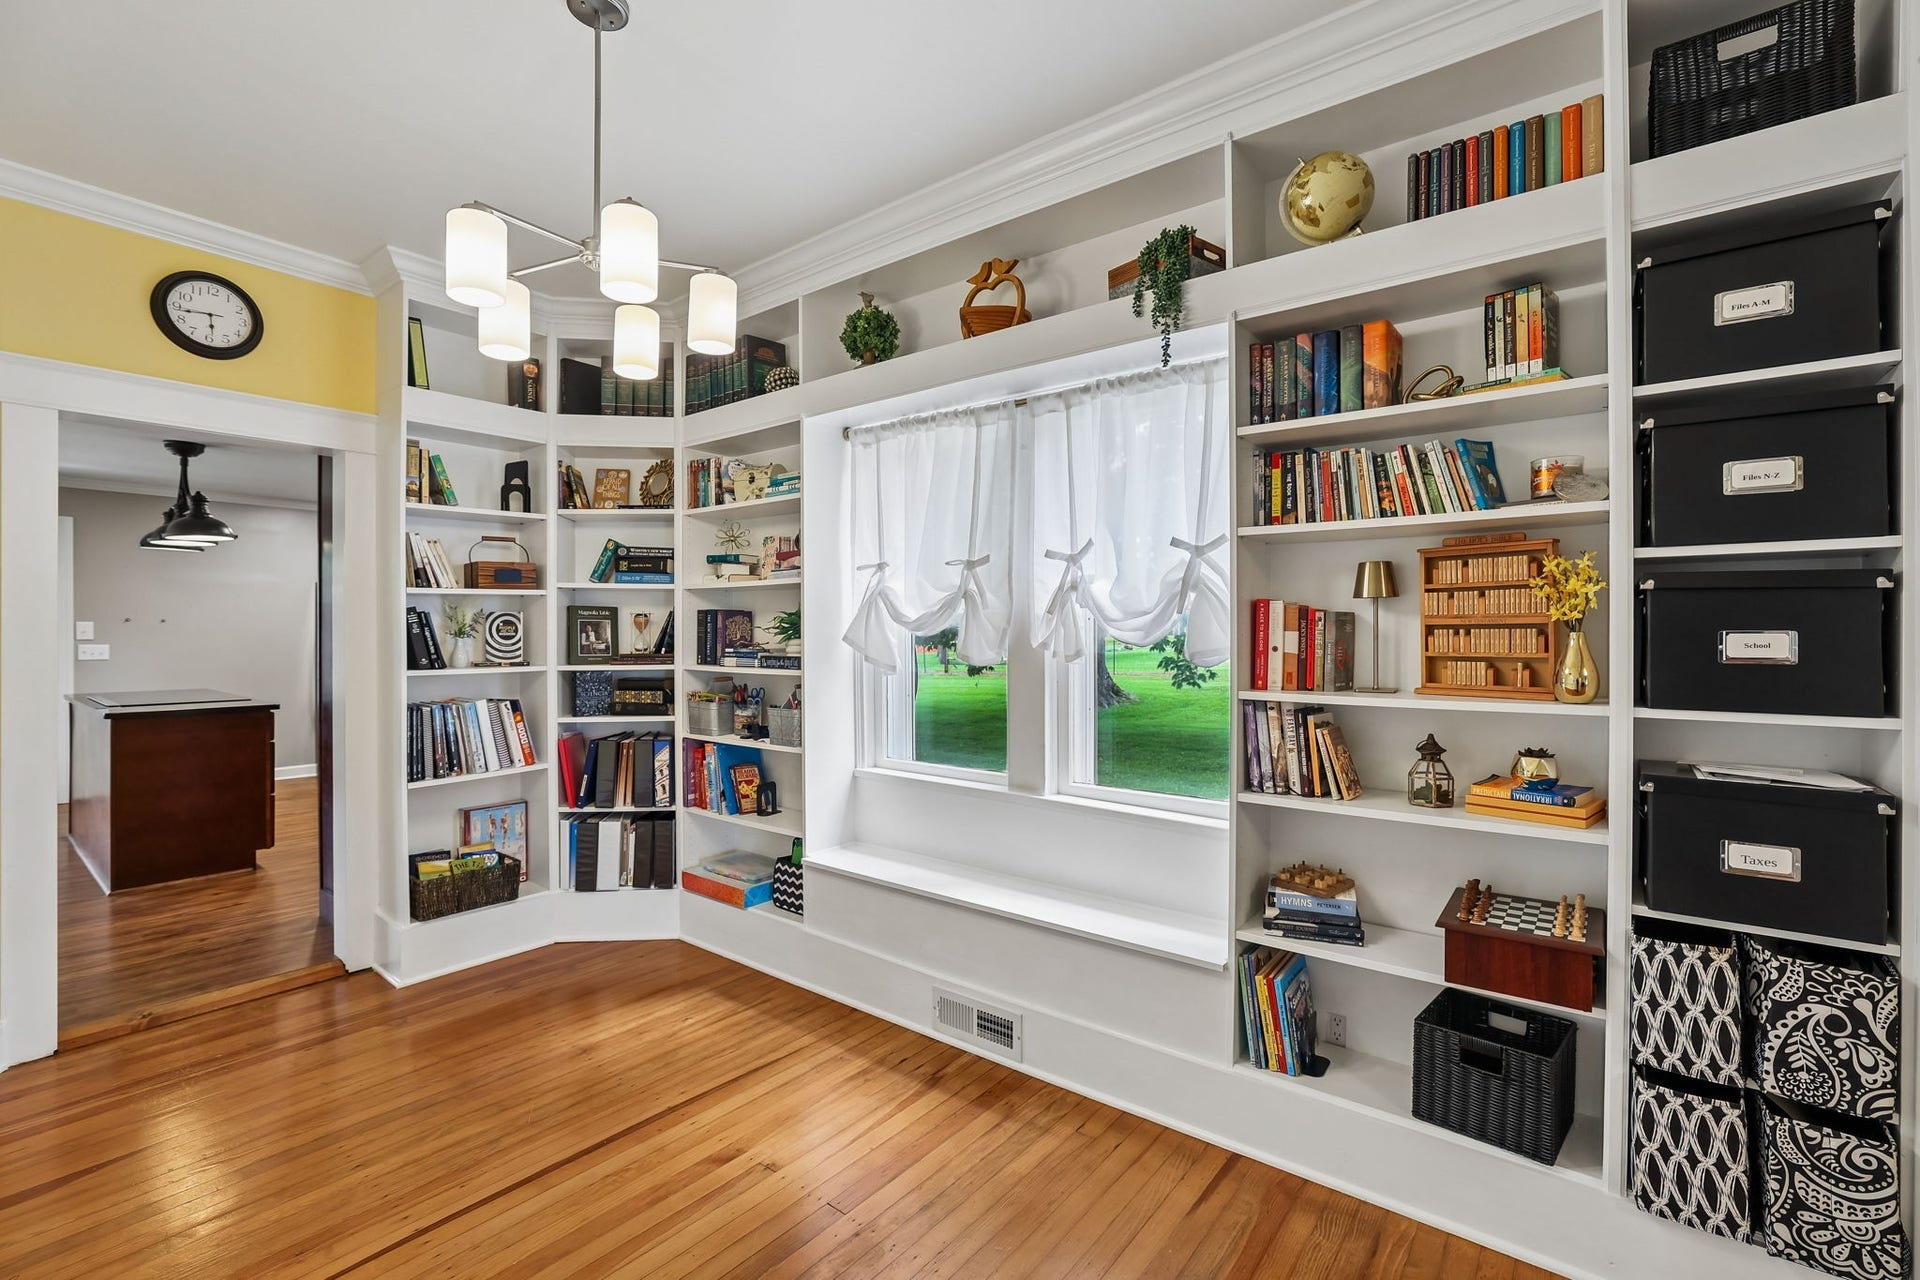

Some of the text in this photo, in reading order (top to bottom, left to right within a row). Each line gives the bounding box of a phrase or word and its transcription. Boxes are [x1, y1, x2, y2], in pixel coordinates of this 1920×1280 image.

[191, 285, 201, 296] 11
[207, 285, 219, 297] 12
[179, 291, 192, 302] 10
[172, 302, 181, 310] 9
[235, 306, 243, 314] 2
[177, 315, 185, 324] 8
[239, 318, 247, 327] 3
[189, 327, 197, 335] 7
[234, 330, 242, 338] 4
[222, 335, 230, 343] 5
[1742, 472, 1780, 482] Files N-Z
[1744, 641, 1771, 650] School
[1285, 708, 1294, 717] NO
[1286, 718, 1295, 734] EASY
[1287, 735, 1296, 747] DAY
[1472, 787, 1552, 804] PREDICTABLY IRRATIONAL
[453, 861, 471, 871] THE
[1740, 854, 1778, 869] Taxes
[1281, 896, 1312, 908] HYMNS
